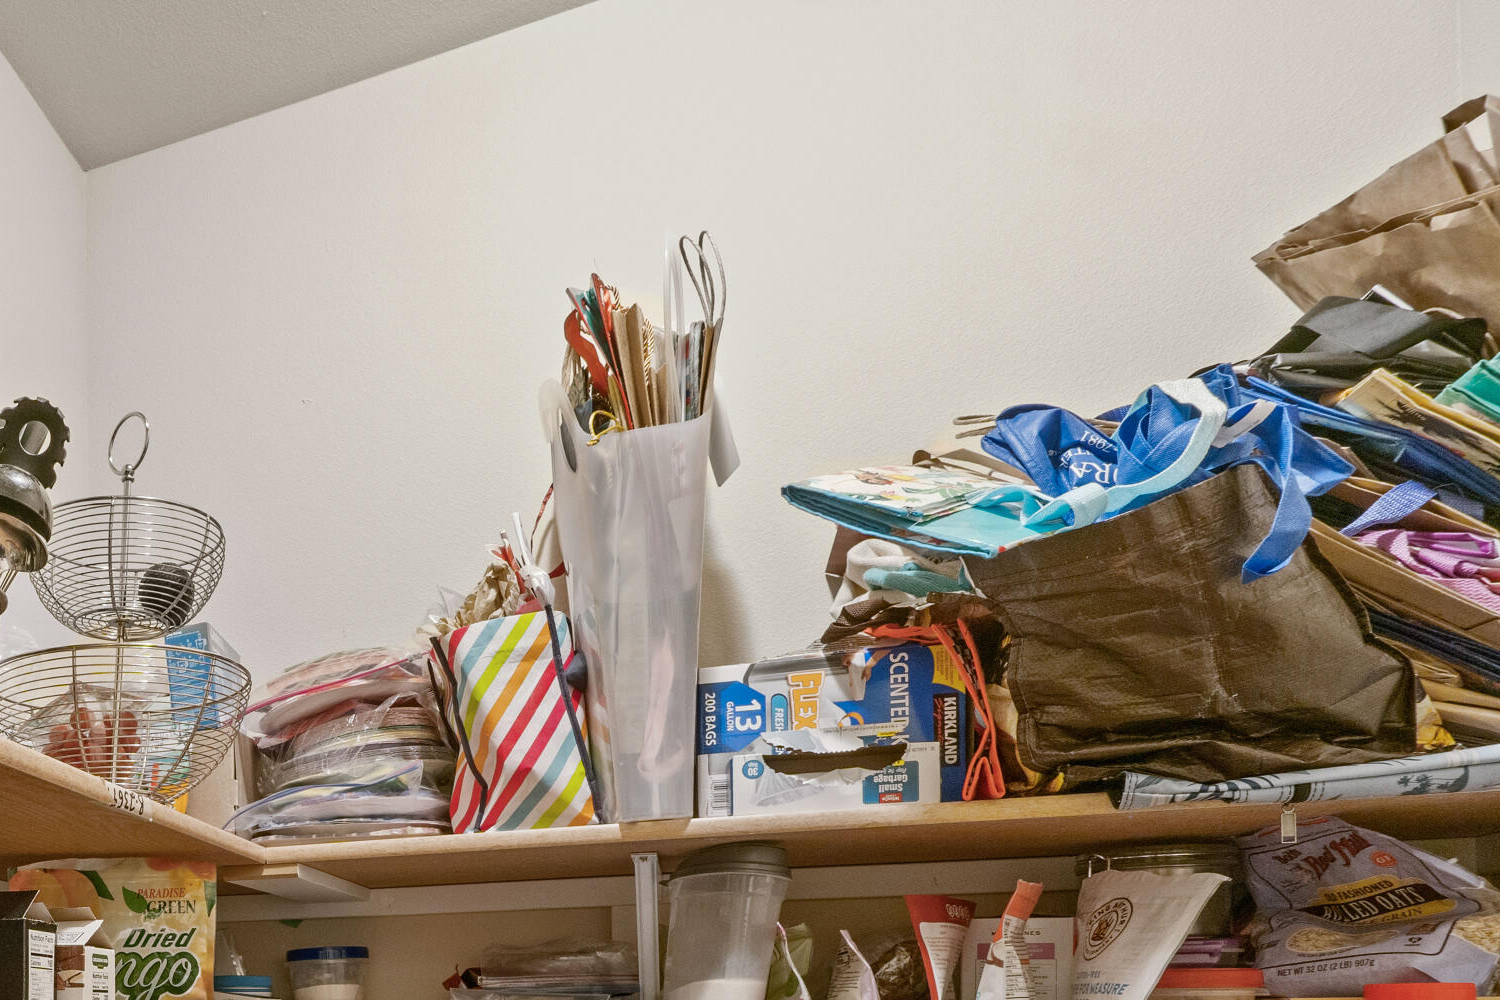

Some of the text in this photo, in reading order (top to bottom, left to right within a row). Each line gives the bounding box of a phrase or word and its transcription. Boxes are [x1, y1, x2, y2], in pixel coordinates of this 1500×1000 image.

[704, 692, 717, 746] 200 BAGS
[726, 701, 734, 732] GALLON
[735, 698, 762, 732] 13
[943, 696, 958, 766] KIRKLAND
[873, 772, 909, 784] Garbage
[878, 781, 903, 792] Small
[137, 887, 185, 898] PARADISE
[1338, 880, 1395, 901] FASHIONED
[1378, 886, 1425, 910] OATS
[146, 899, 196, 915] GREEN
[123, 928, 196, 948] Dried
[1277, 964, 1329, 977] NET WT 32 OZ
[1090, 983, 1130, 996] MEASURE
